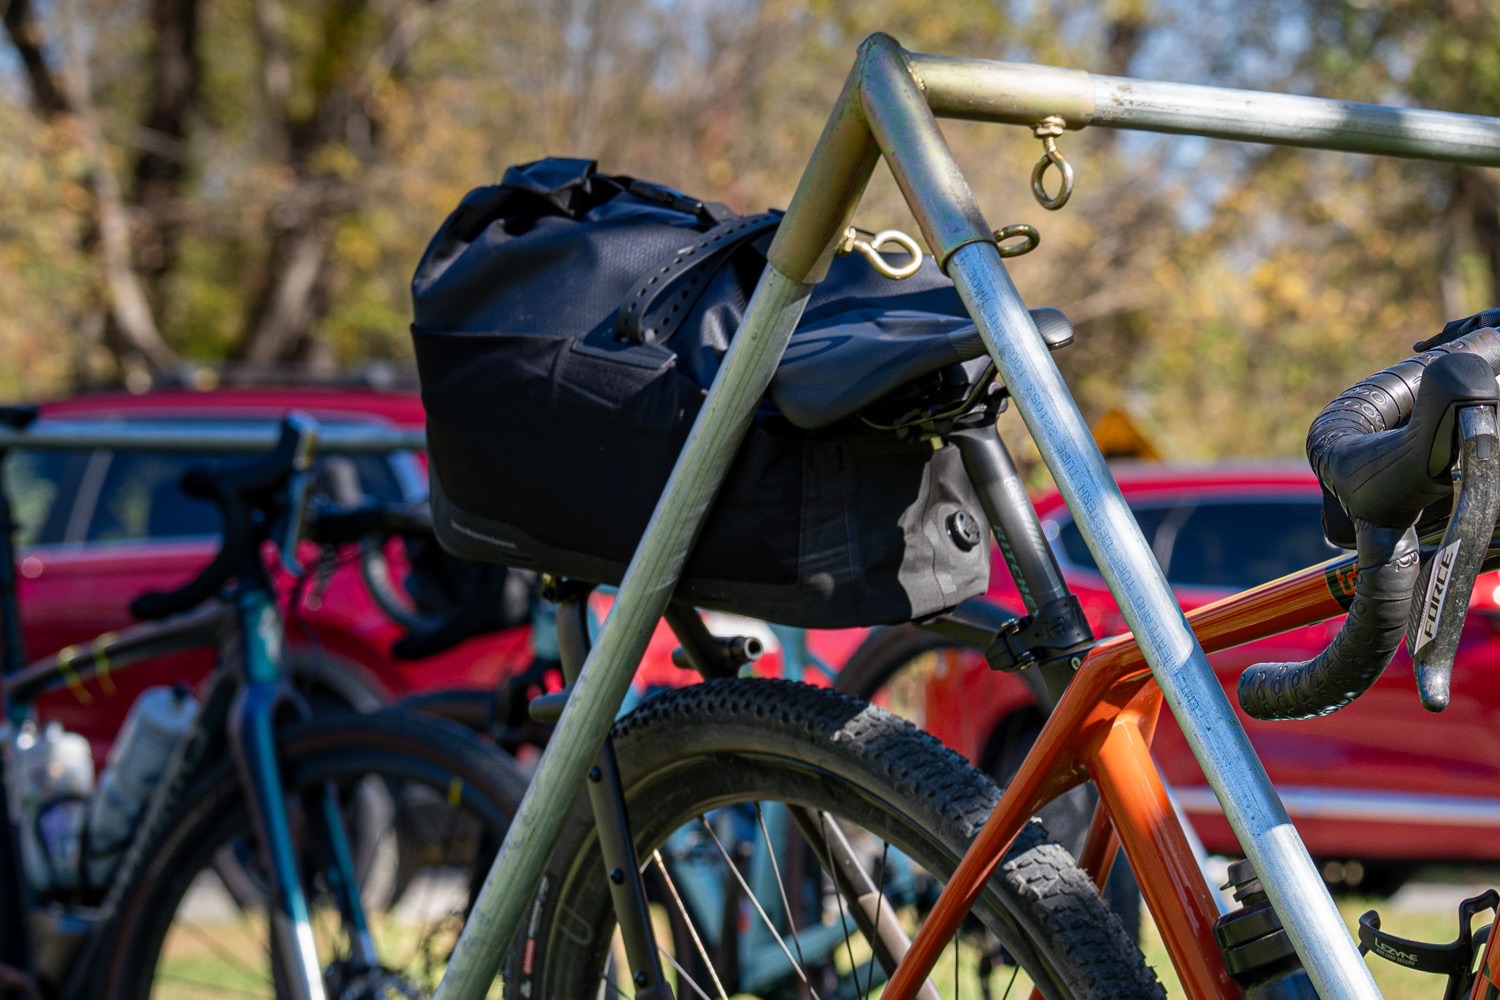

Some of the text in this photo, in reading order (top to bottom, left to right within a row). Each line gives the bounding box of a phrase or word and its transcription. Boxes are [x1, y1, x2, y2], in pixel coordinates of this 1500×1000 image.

[1054, 442, 1081, 480] TUBE
[1424, 548, 1454, 639] FORCE
[1375, 937, 1418, 962] LEZYNE
